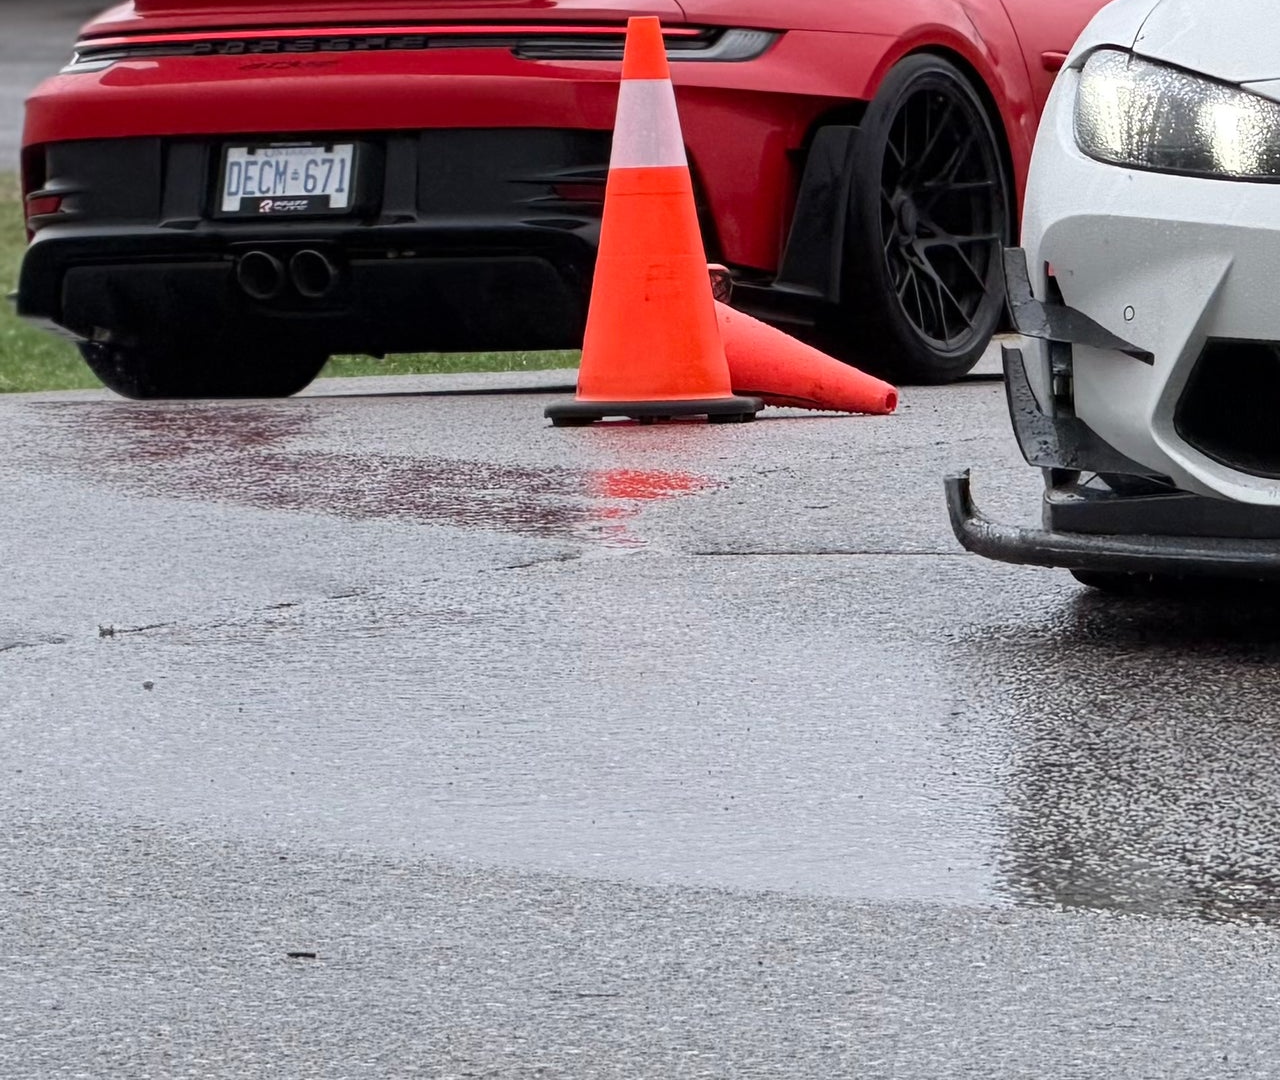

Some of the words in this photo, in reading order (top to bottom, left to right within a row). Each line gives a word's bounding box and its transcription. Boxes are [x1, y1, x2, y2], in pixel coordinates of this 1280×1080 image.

[191, 36, 427, 55] PORSCHE
[226, 160, 288, 196] DECM
[303, 157, 346, 194] 671
